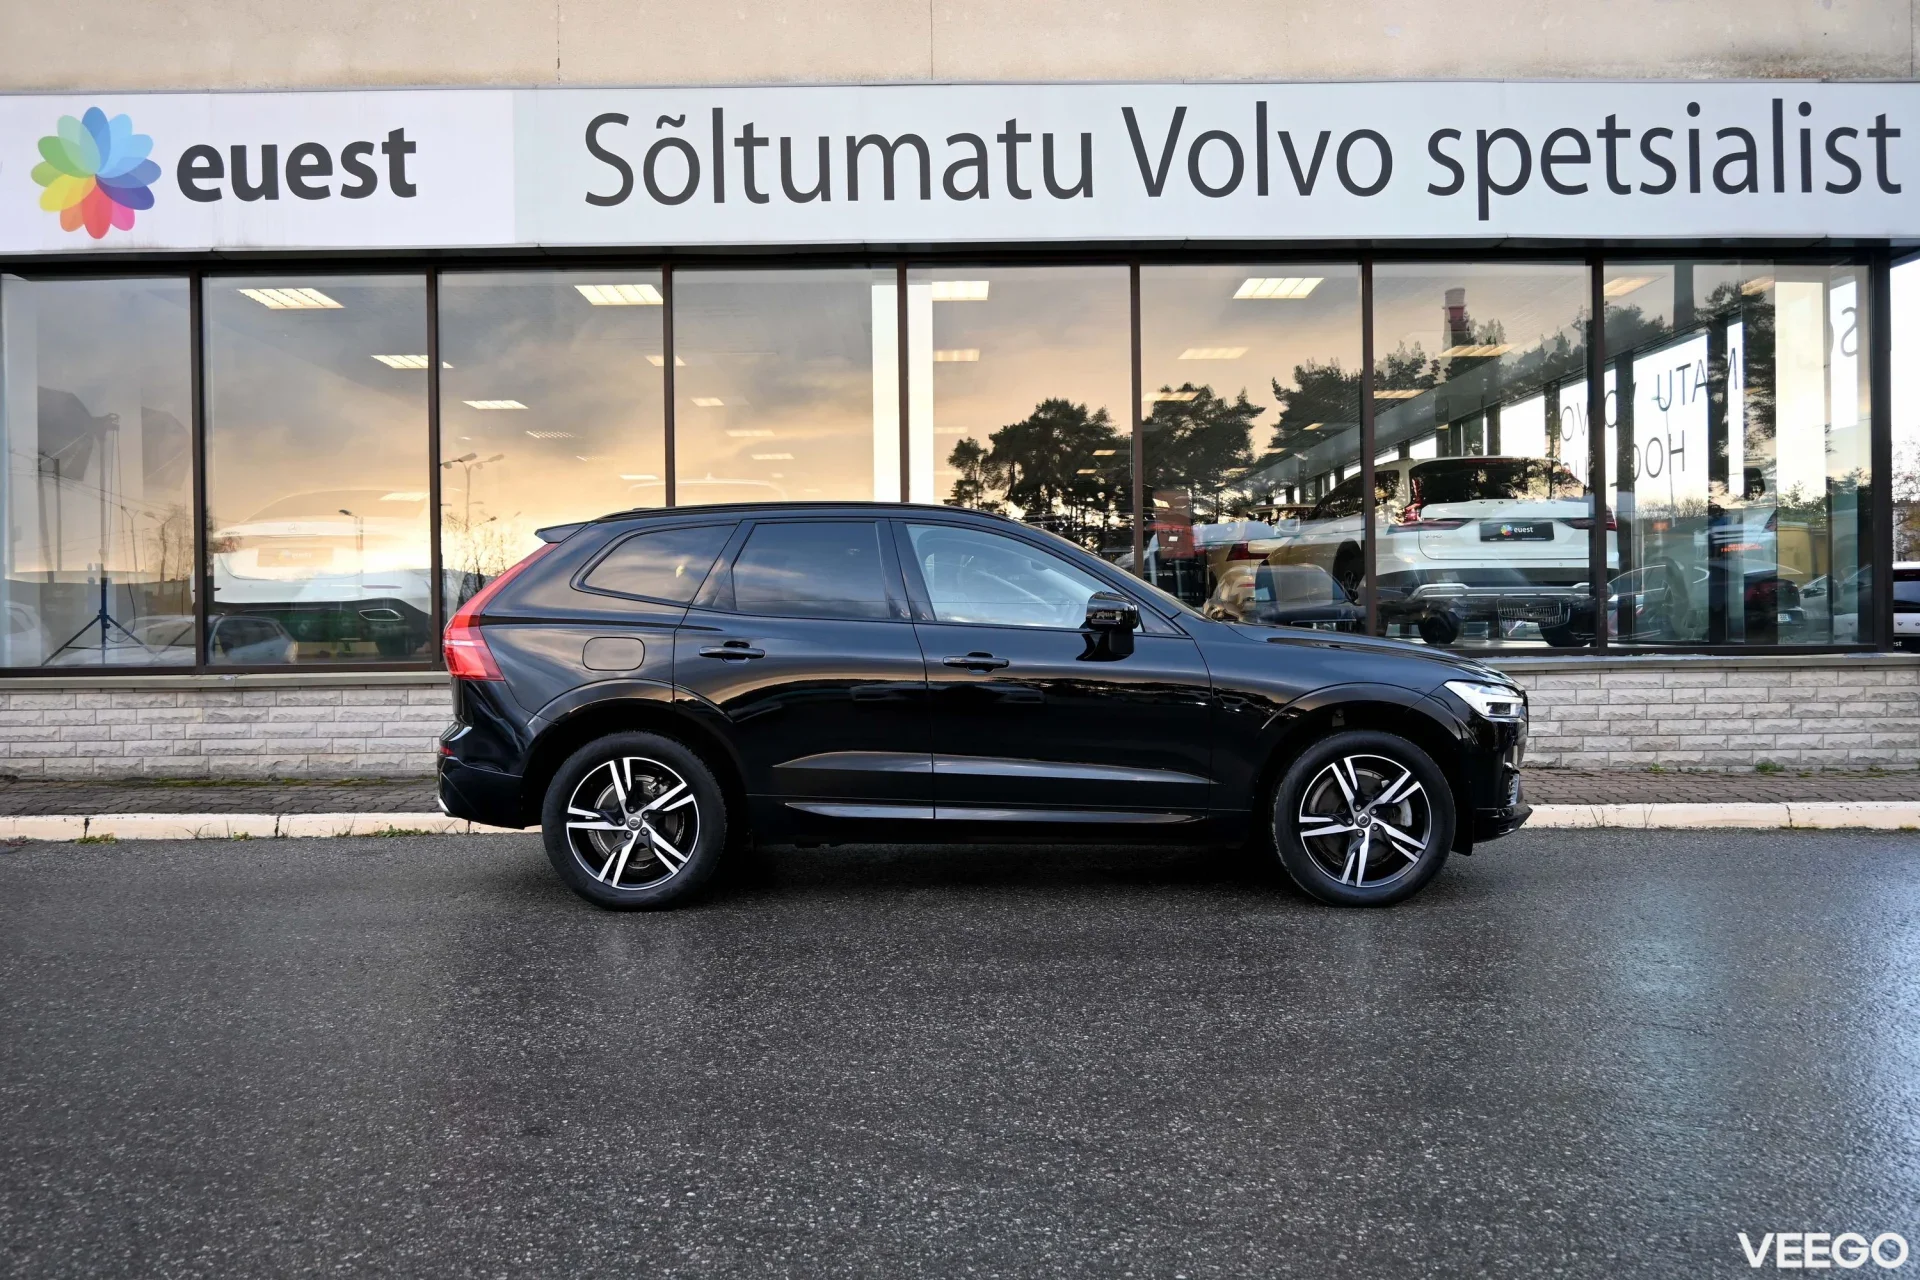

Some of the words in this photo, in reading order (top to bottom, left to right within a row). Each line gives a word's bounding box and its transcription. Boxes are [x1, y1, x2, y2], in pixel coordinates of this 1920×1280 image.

[176, 127, 417, 203] euest
[584, 107, 1094, 207] Sõltumatu
[1121, 100, 1393, 198] Volvo
[1427, 98, 1902, 221] spetsialist
